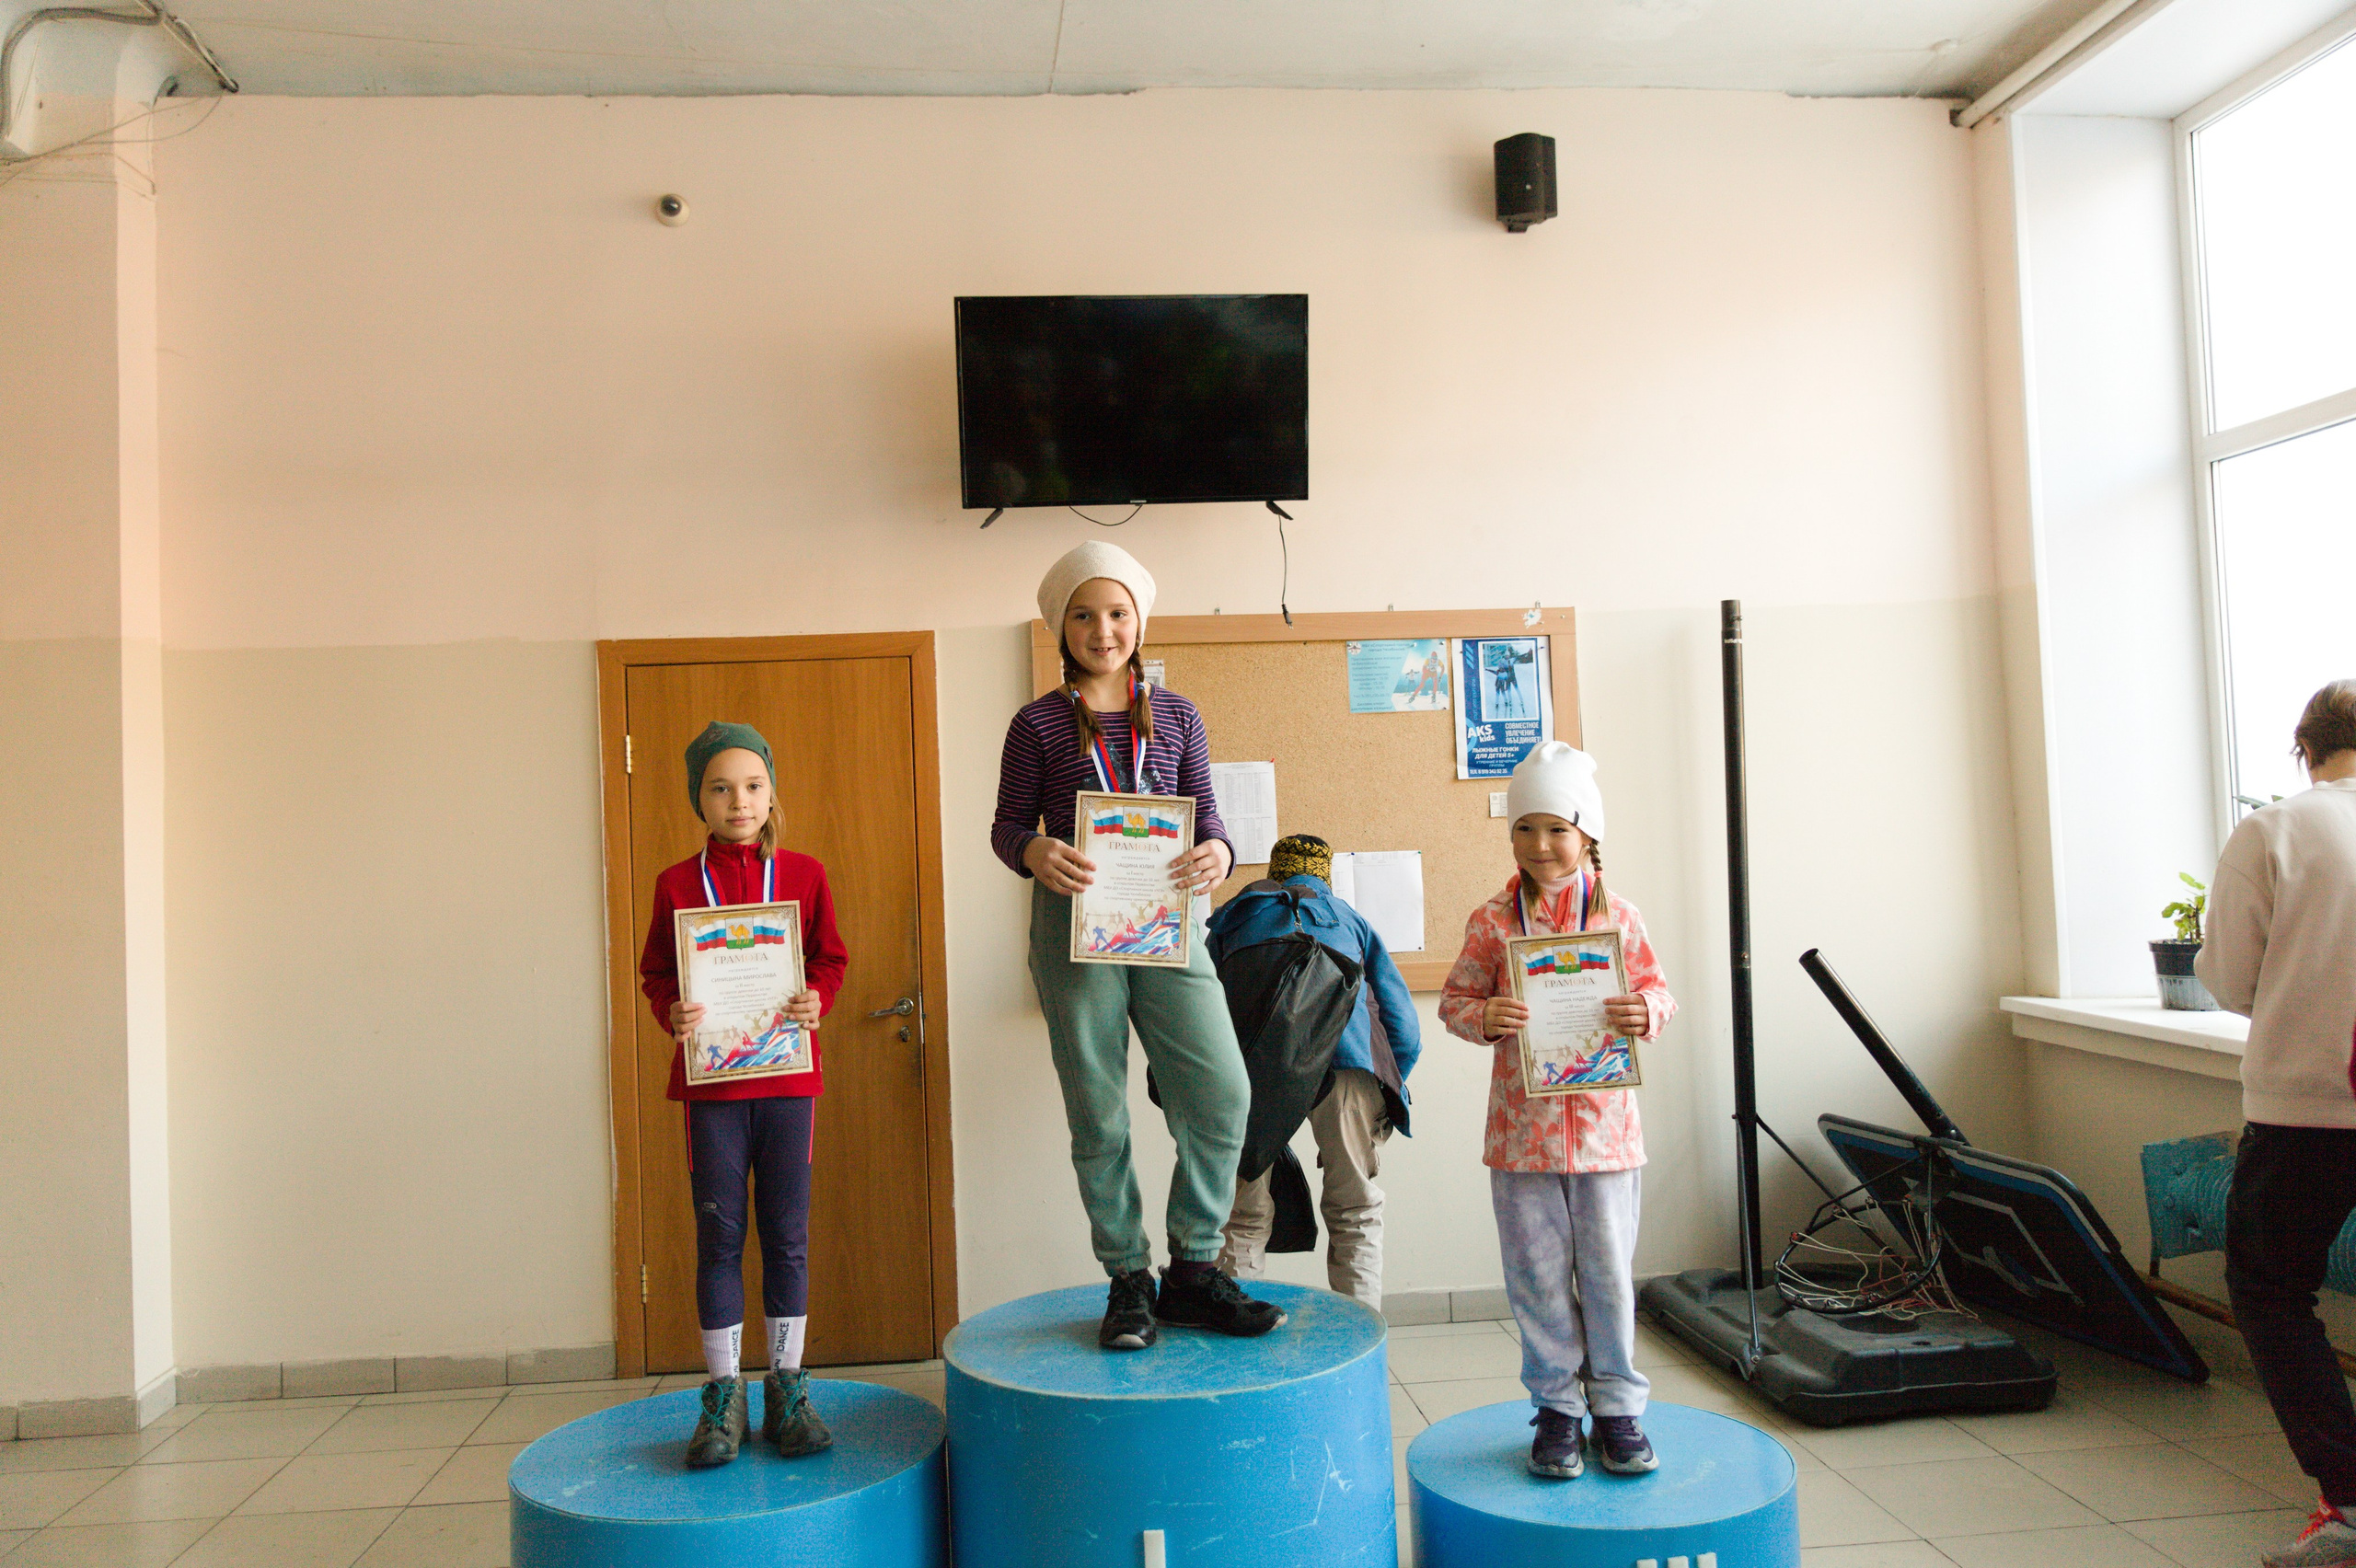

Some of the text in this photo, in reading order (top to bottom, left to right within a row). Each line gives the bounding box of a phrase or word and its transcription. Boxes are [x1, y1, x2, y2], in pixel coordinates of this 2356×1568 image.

[1467, 724, 1493, 738] AKS
[1505, 729, 1536, 737] УВЛЕЧЕНИЕ
[1108, 841, 1161, 852] ГРАМОТА
[713, 952, 768, 964] ГРАМОТА
[1544, 977, 1595, 987] ГРАМОТА
[777, 1322, 790, 1352] DANCE
[732, 1329, 740, 1359] DANCE
